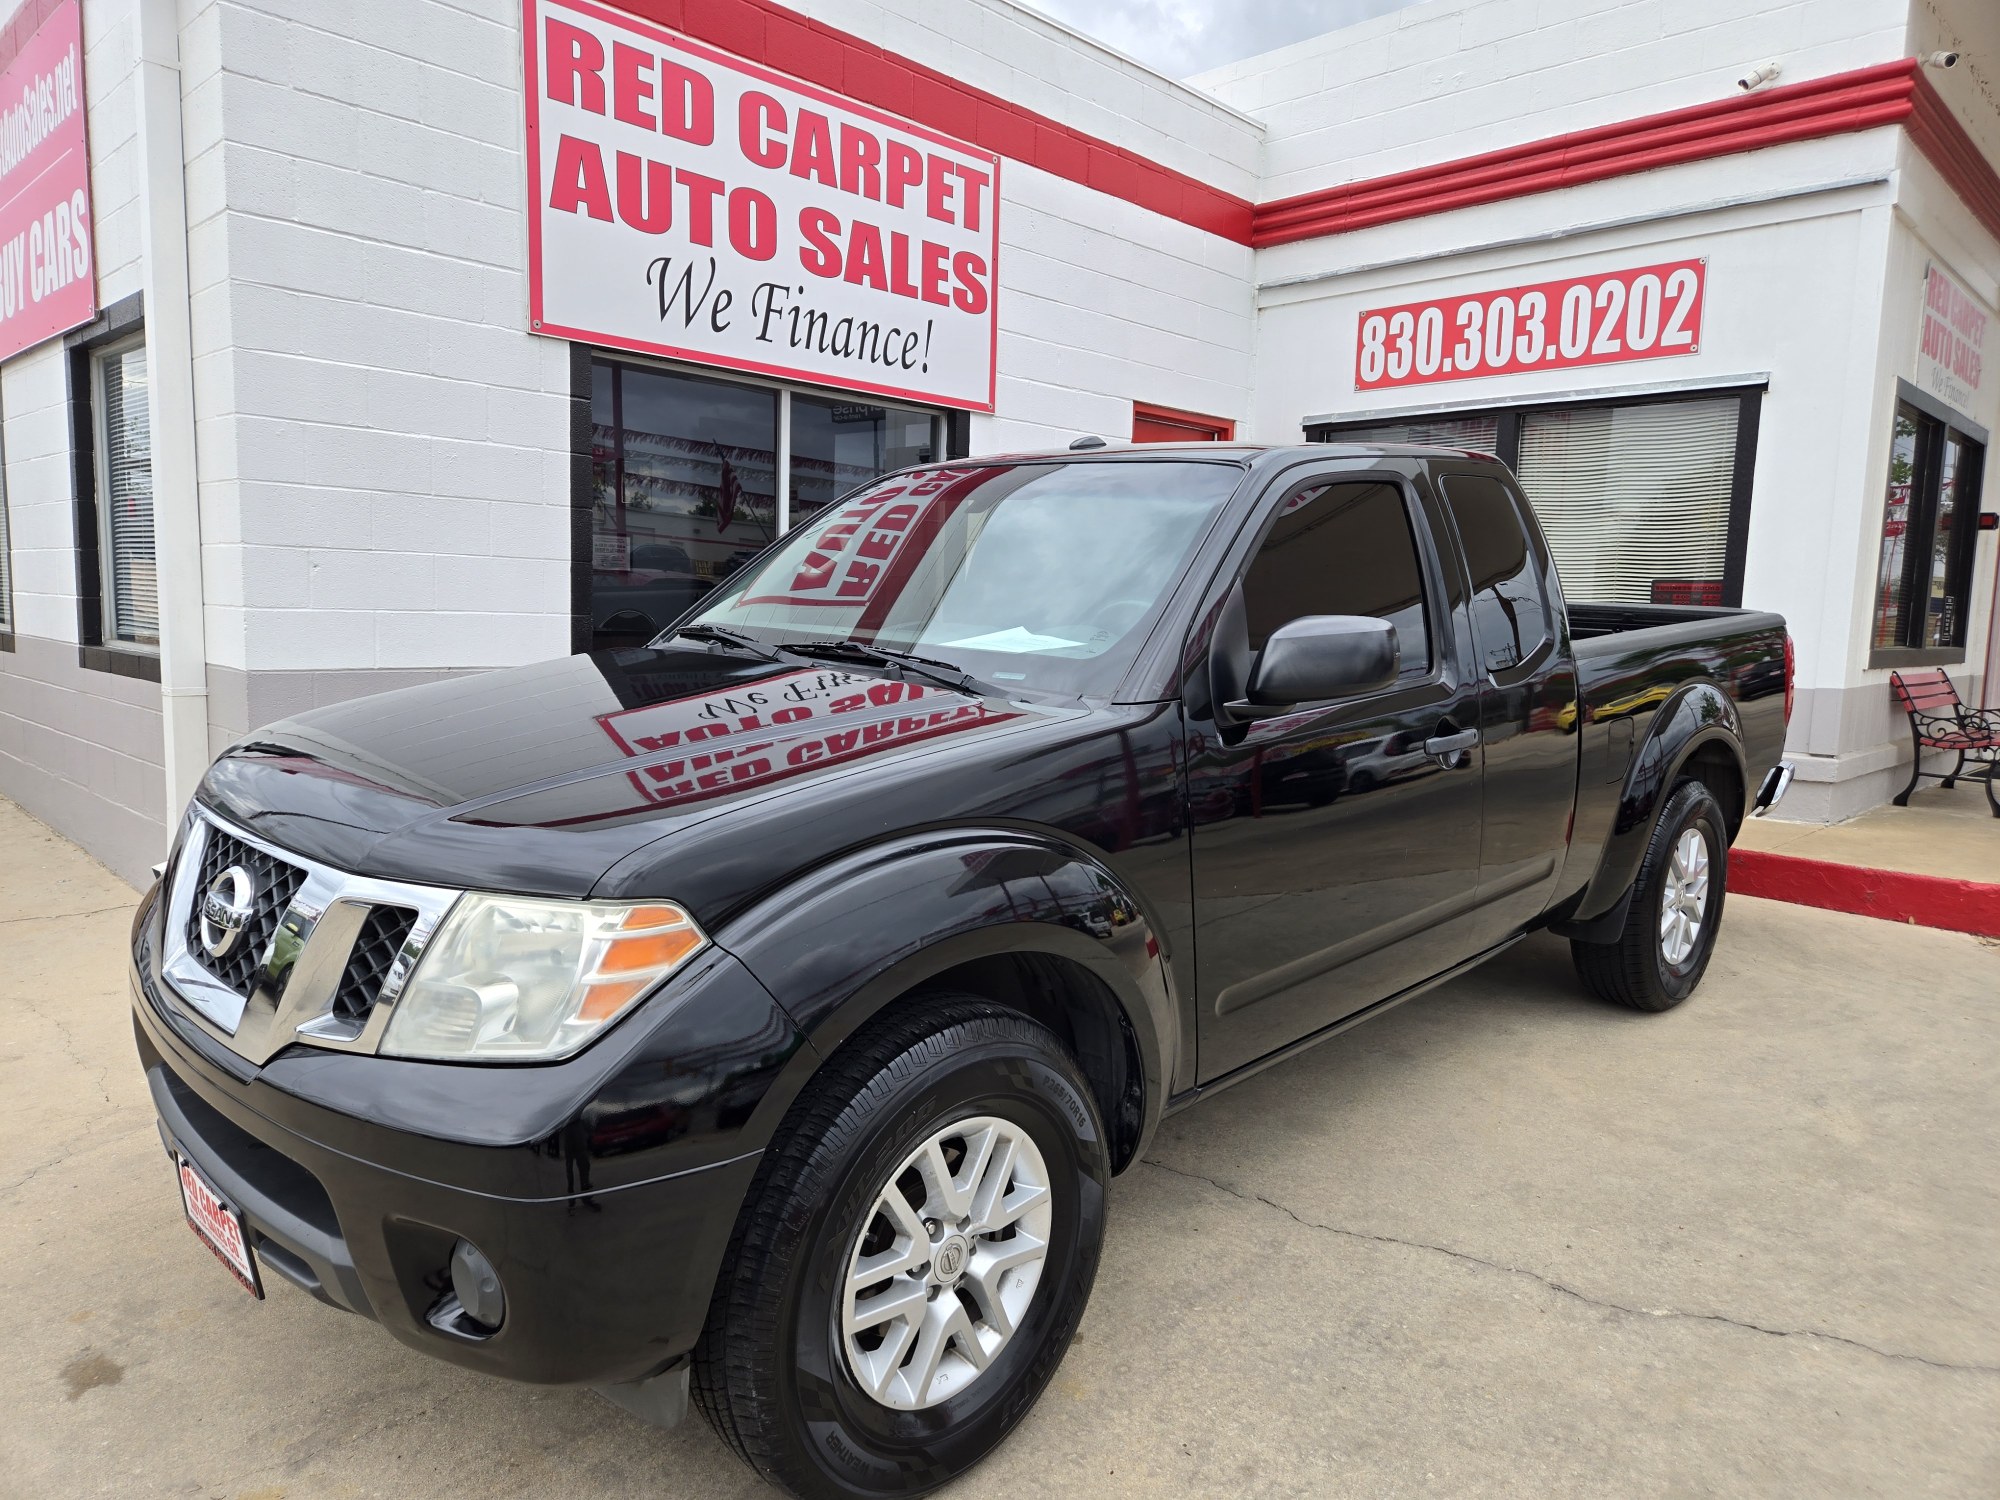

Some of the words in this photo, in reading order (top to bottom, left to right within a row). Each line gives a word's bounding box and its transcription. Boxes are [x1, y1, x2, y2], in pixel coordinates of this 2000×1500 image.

[545, 15, 714, 146] RED
[739, 90, 989, 232] CARPET
[30, 188, 88, 303] CARS
[549, 133, 777, 261] AUTO
[799, 206, 987, 314] SALES
[646, 257, 733, 332] We
[751, 282, 933, 373] Finance!
[1360, 268, 1698, 382] 830.303.0202
[1926, 267, 1951, 319] RED
[1921, 314, 1953, 370] AUTO
[1953, 337, 1981, 390] SALES
[1042, 1075, 1086, 1128] P265/70R16
[181, 1167, 199, 1203] RED
[199, 1186, 241, 1247] CARPET
[826, 1430, 870, 1476] WEATHER
